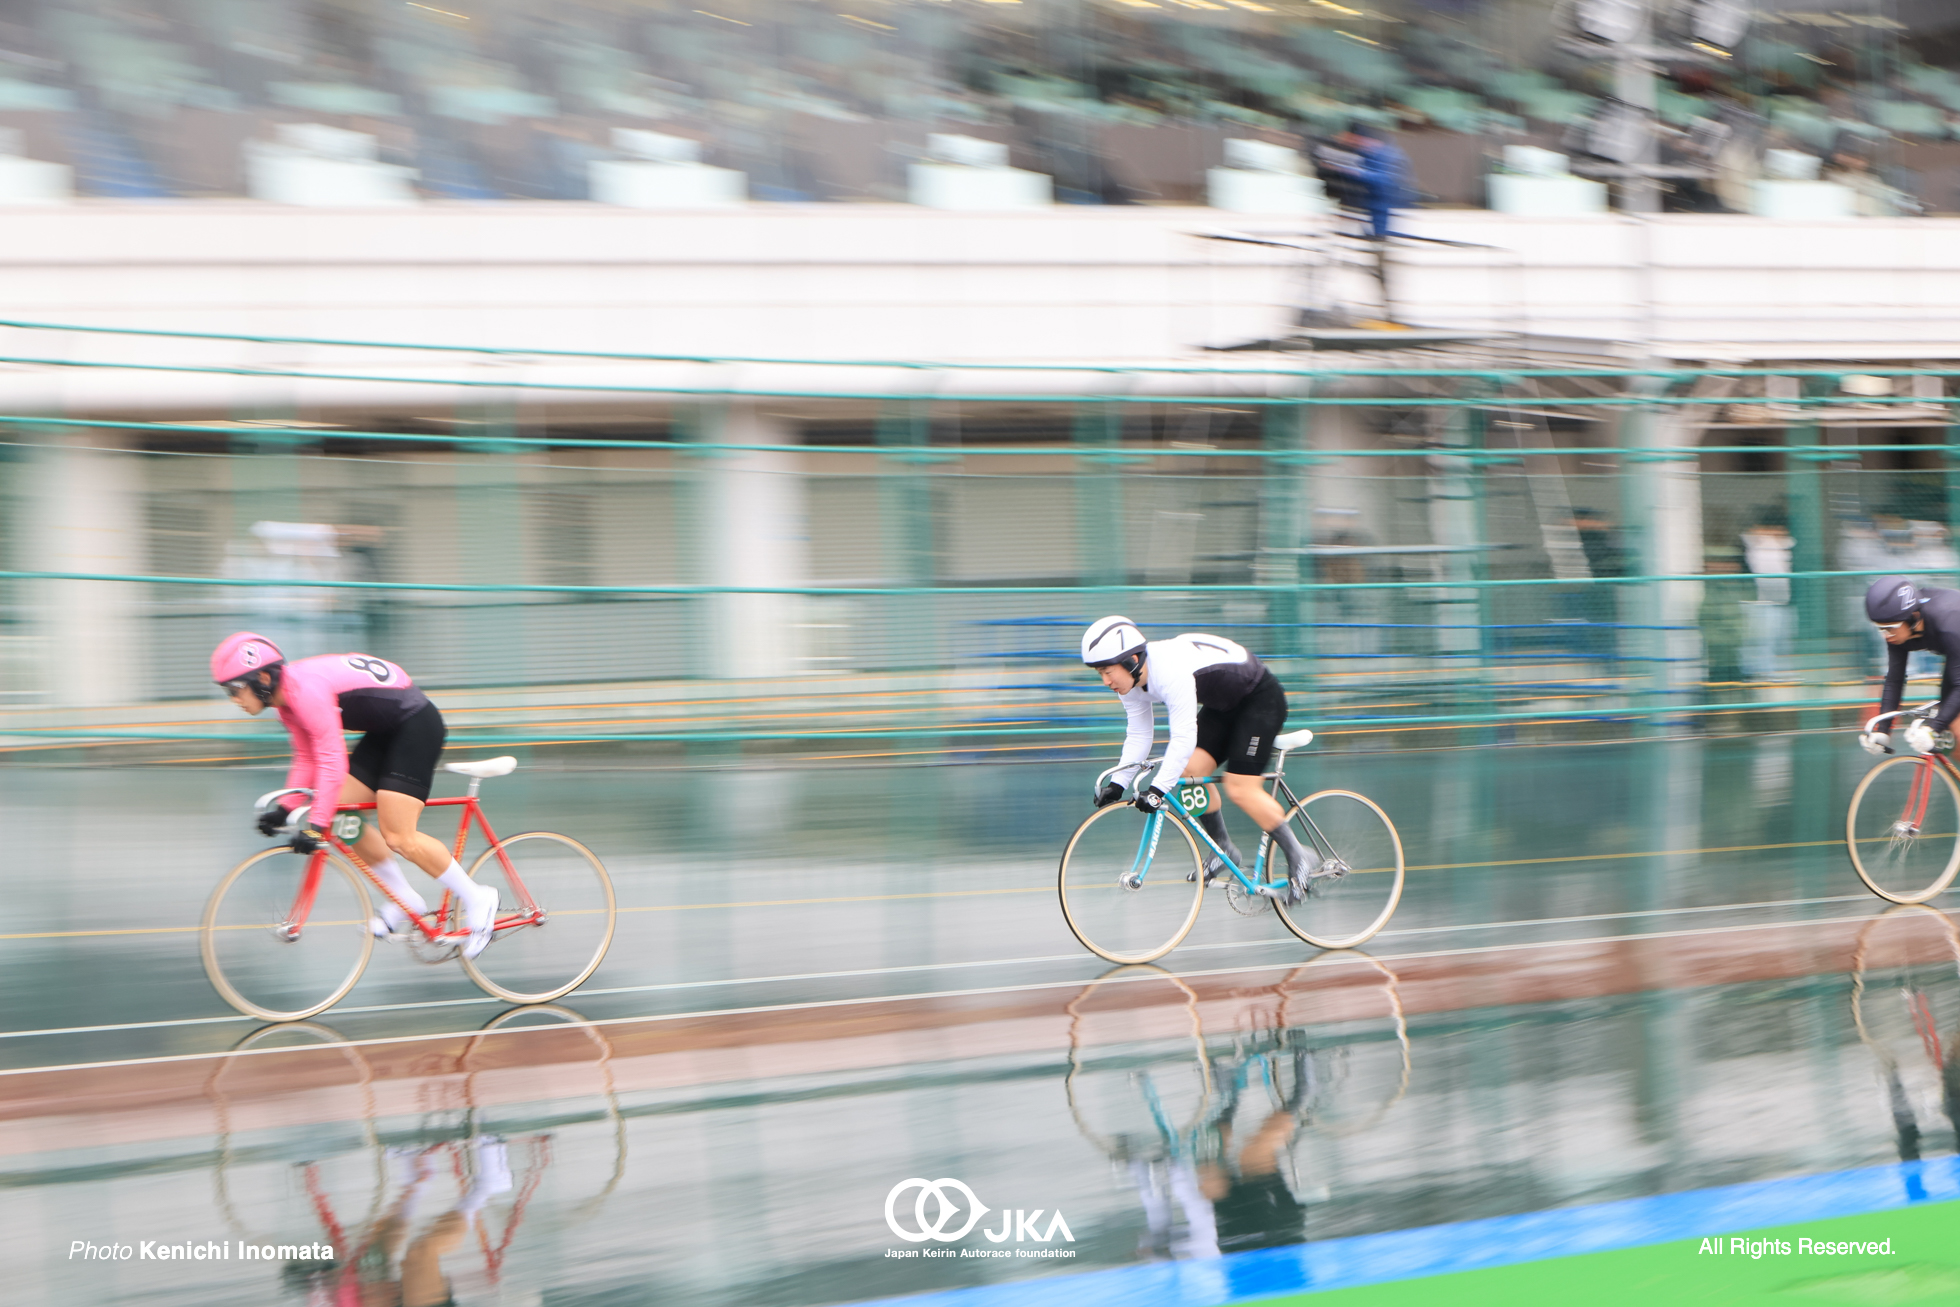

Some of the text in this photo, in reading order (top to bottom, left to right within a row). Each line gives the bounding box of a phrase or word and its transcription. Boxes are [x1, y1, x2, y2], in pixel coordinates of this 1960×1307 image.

[1897, 585, 1916, 610] 2
[1116, 629, 1125, 651] 1
[238, 641, 262, 668] 8
[344, 656, 395, 685] 8
[1181, 786, 1208, 811] 58
[1149, 814, 1164, 860] MAKINO
